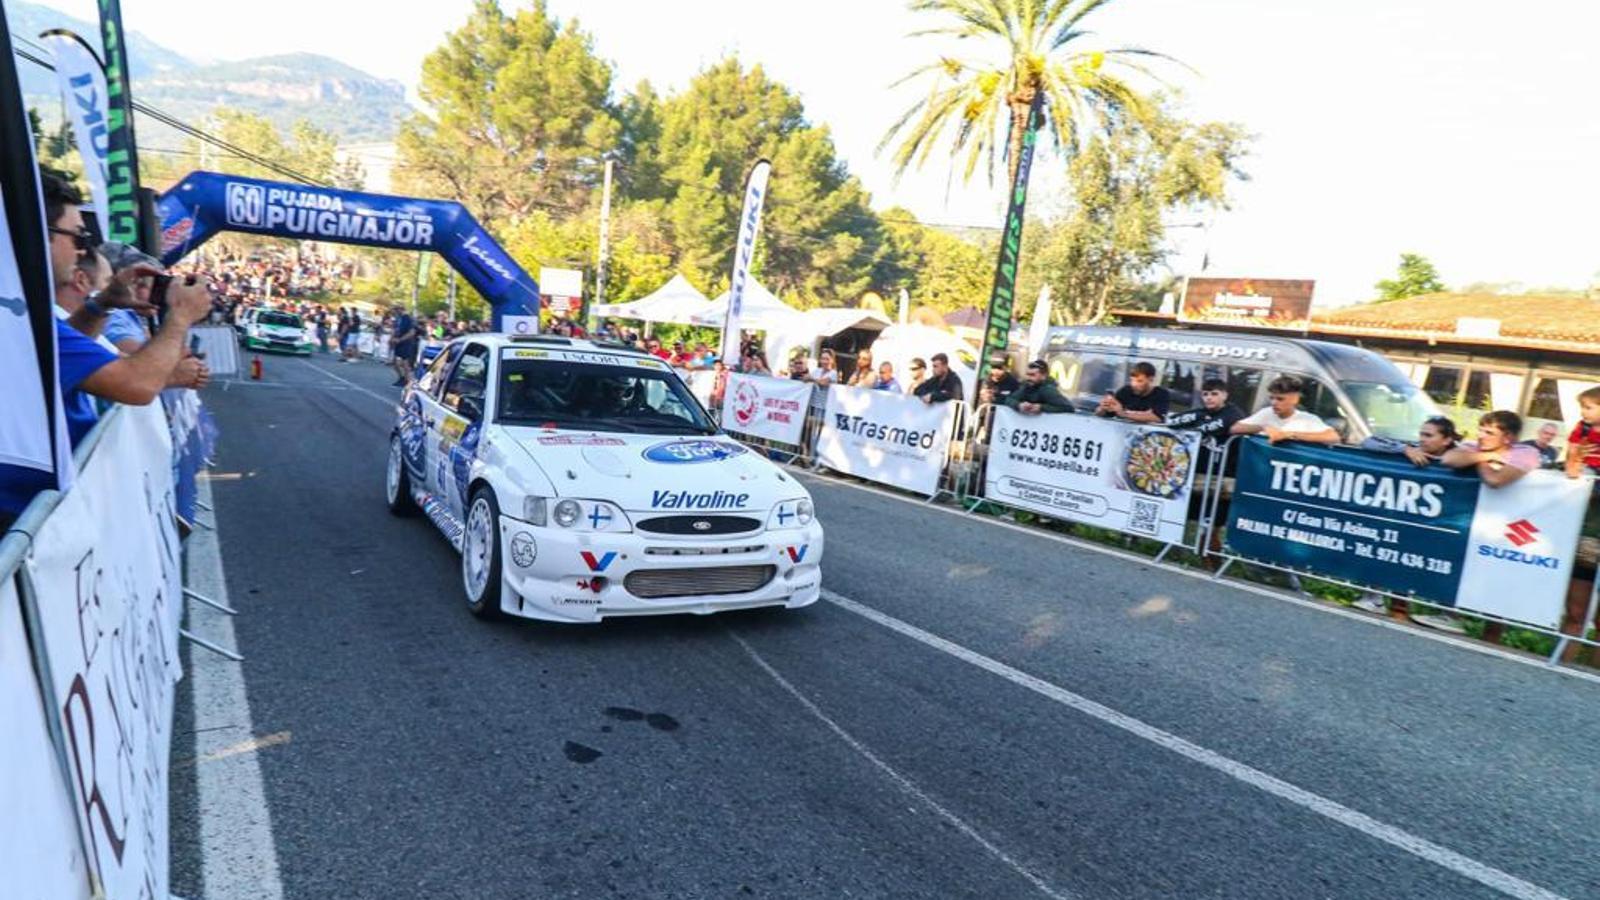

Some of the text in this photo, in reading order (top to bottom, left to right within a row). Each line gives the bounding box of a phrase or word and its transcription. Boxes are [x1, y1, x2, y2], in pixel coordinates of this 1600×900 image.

[231, 185, 259, 225] 60
[268, 188, 343, 212] PUJADA
[266, 205, 434, 246] PUIGMAJOR
[733, 187, 760, 316] SUZUKI
[1136, 336, 1269, 360] Motorsport
[852, 415, 937, 450] Trasmed
[1011, 428, 1103, 462] 623 38 65 61
[651, 490, 749, 509] Valvoline
[1270, 459, 1444, 519] TECNICARS
[1236, 517, 1271, 536] PALMA
[1271, 524, 1288, 540] DE
[1286, 528, 1346, 553] MALLORCA
[1376, 546, 1400, 564] 971
[1282, 508, 1297, 524] C/
[1297, 511, 1322, 528] Gran
[1382, 529, 1400, 544] 11
[1478, 544, 1561, 570] SUZUKI
